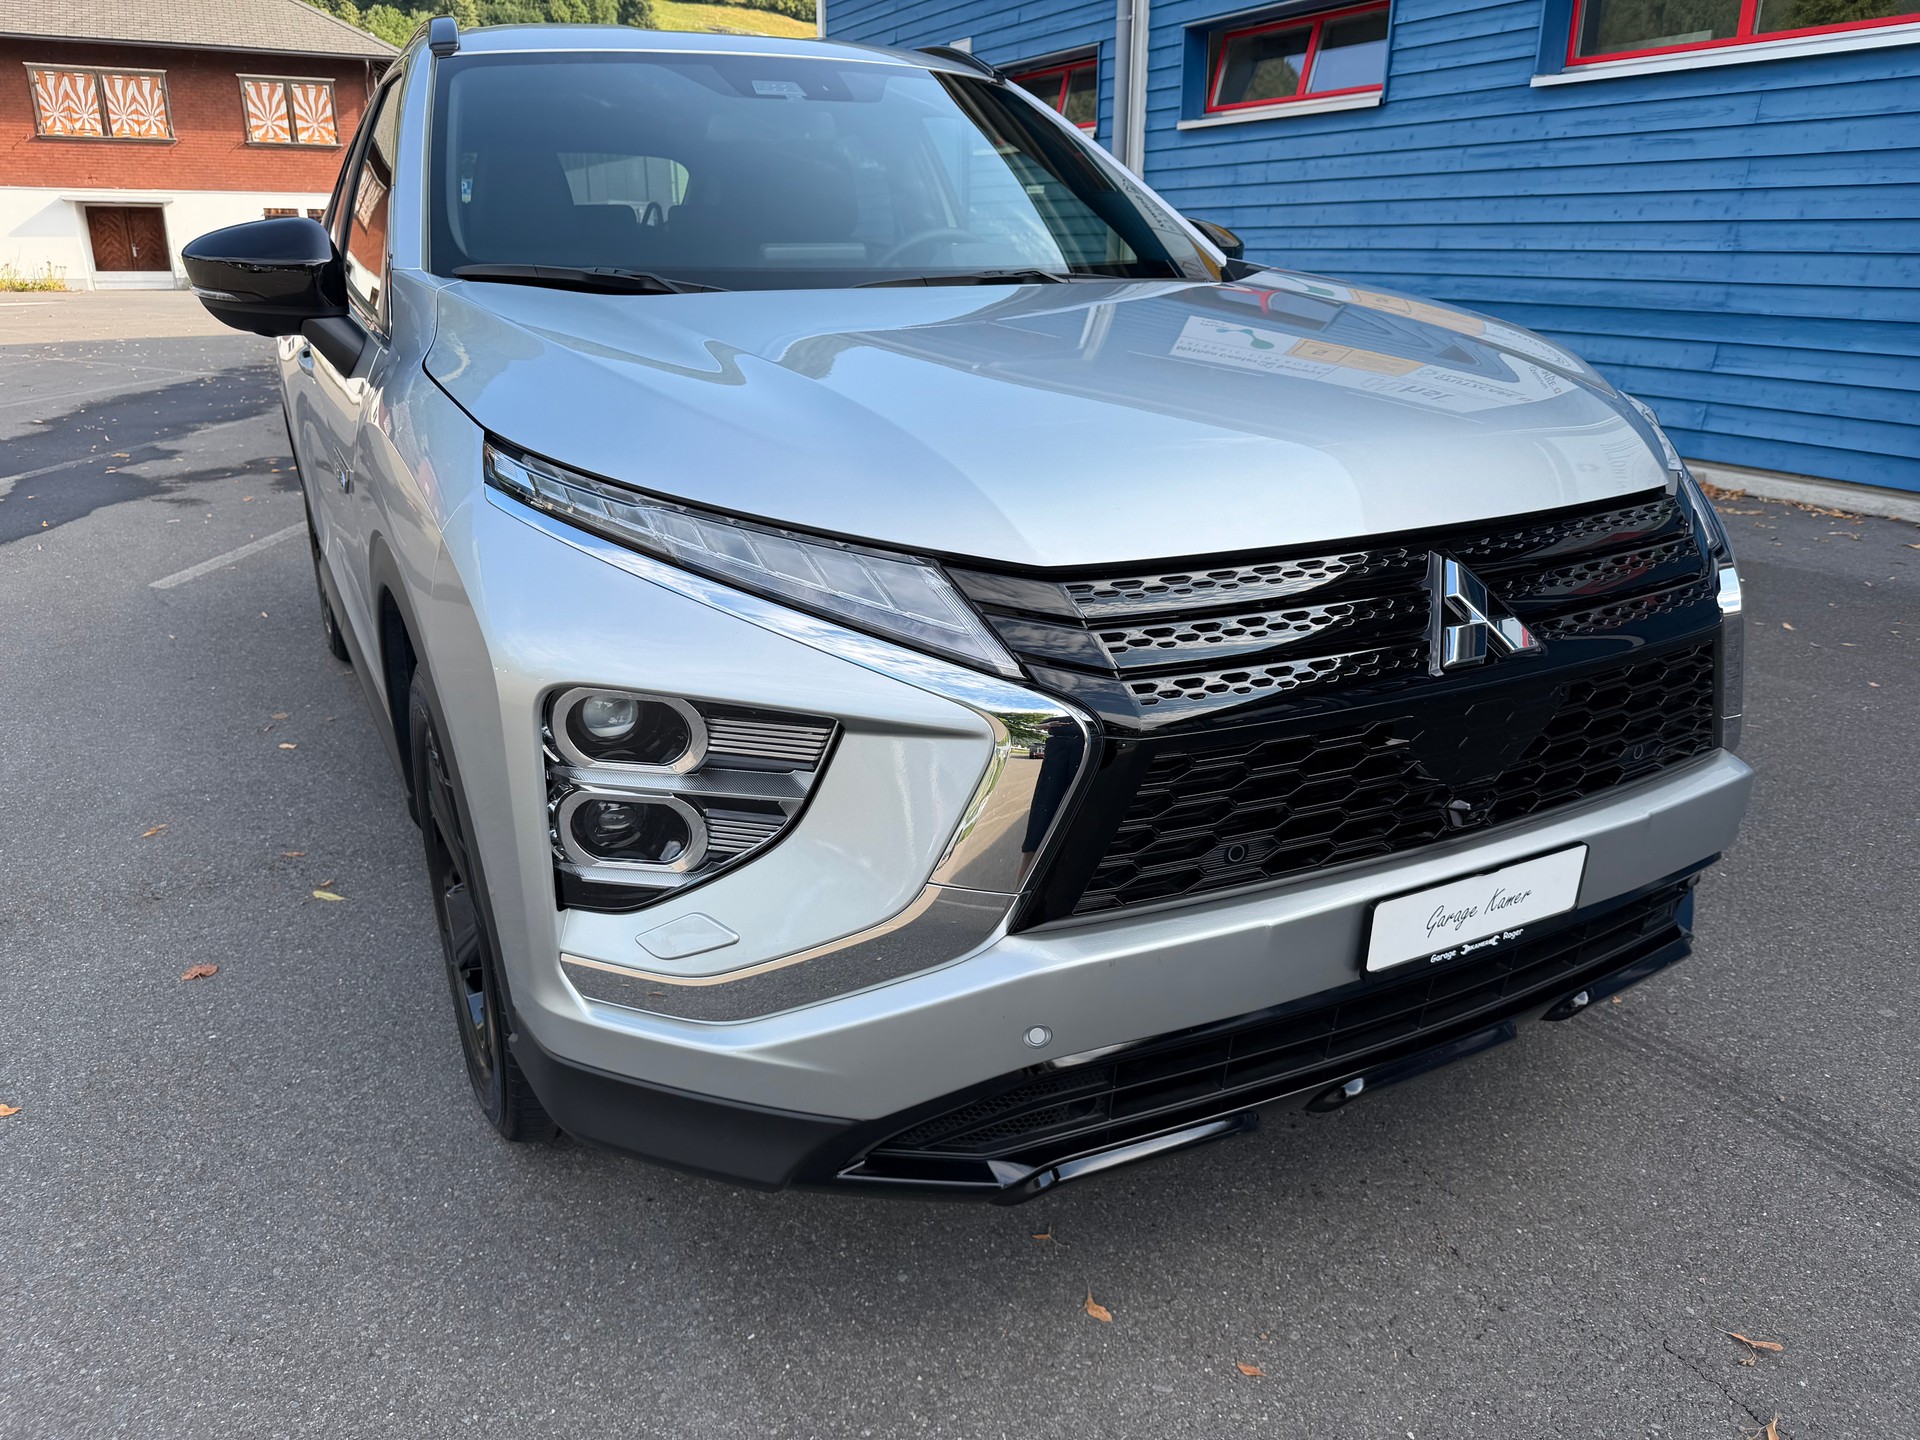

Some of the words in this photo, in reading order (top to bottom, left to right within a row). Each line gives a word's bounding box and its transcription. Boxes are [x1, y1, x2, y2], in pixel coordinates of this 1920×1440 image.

[1426, 905, 1478, 938] Garage
[1484, 888, 1532, 915] Kamer
[1430, 950, 1457, 963] Garage
[1503, 929, 1524, 940] Roger
